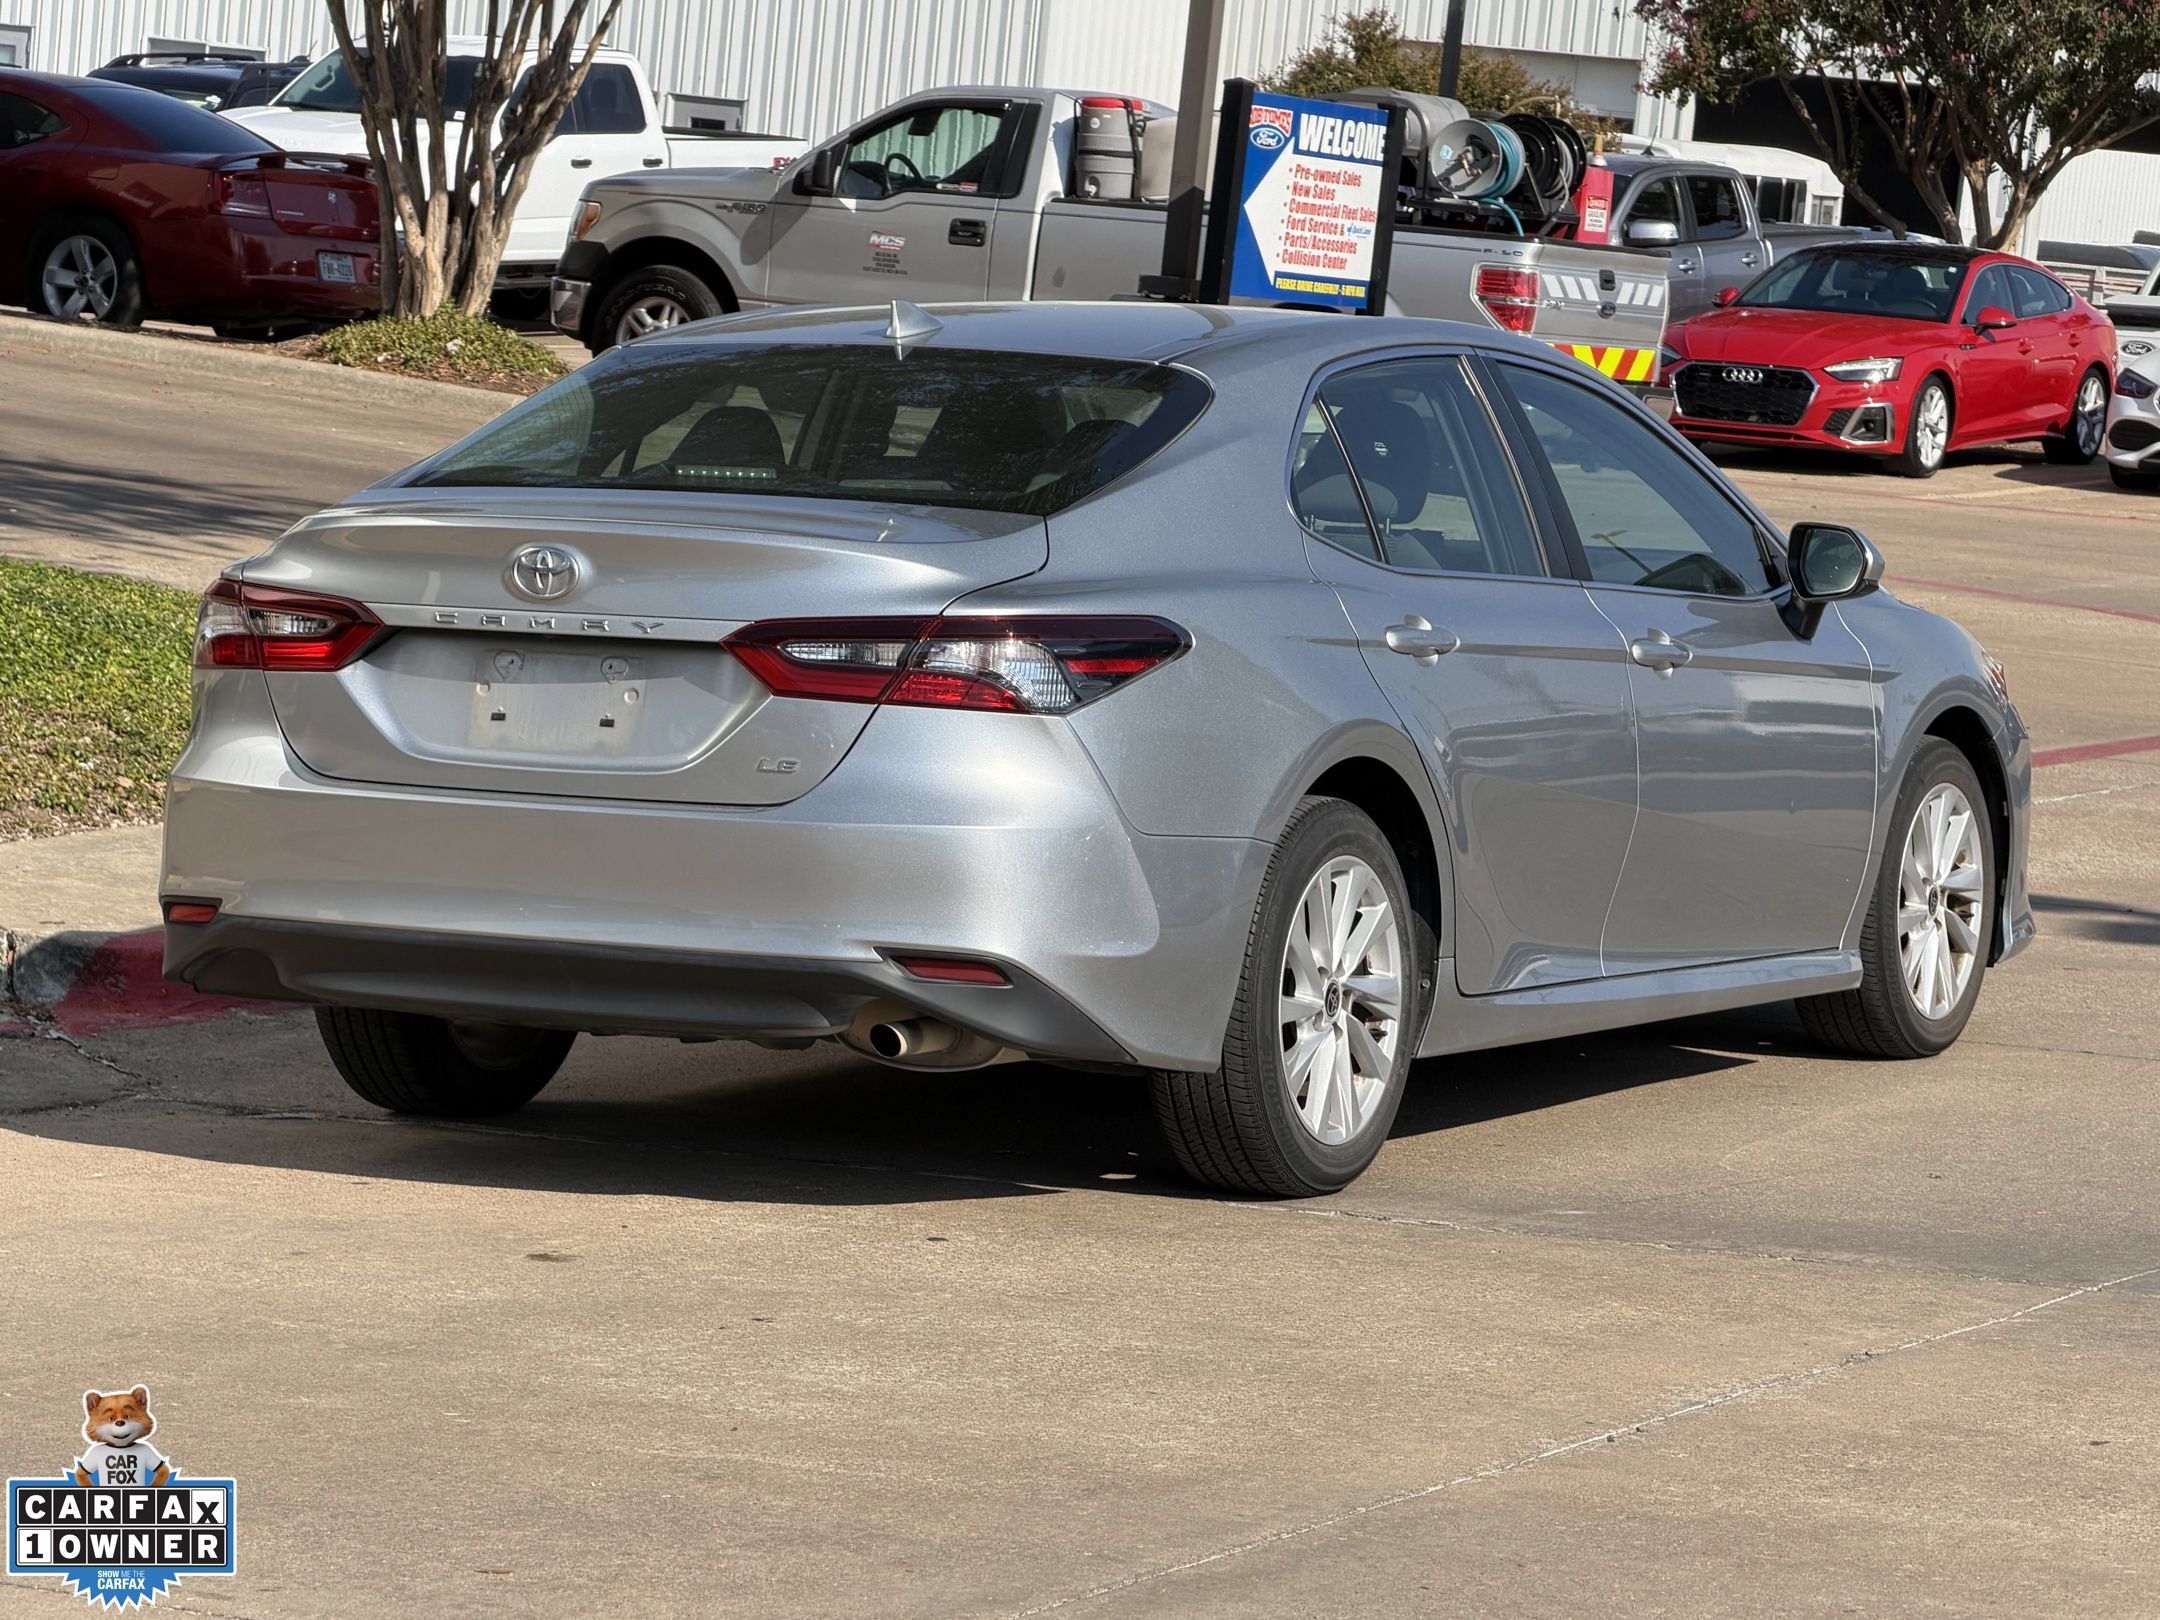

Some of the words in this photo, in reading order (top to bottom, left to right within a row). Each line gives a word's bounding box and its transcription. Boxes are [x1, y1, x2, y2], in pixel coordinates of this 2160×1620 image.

[1299, 113, 1387, 161] WELCOME
[1294, 163, 1342, 185] Pre-owned
[1342, 170, 1362, 187] Sales
[1291, 181, 1312, 198] New
[1312, 183, 1336, 201] Sales
[1289, 198, 1341, 218] Commercial
[1341, 204, 1359, 221] Fleet
[1359, 207, 1376, 223] Sales
[1286, 215, 1307, 231] Ford
[1308, 217, 1339, 236] Service
[1339, 223, 1345, 236] &
[869, 233, 905, 247] MCS
[1284, 231, 1358, 254] Parts/Accessories
[1281, 248, 1321, 268] Collision
[1322, 253, 1348, 270] Center
[434, 611, 665, 634] CAMRY
[756, 757, 799, 774] LE
